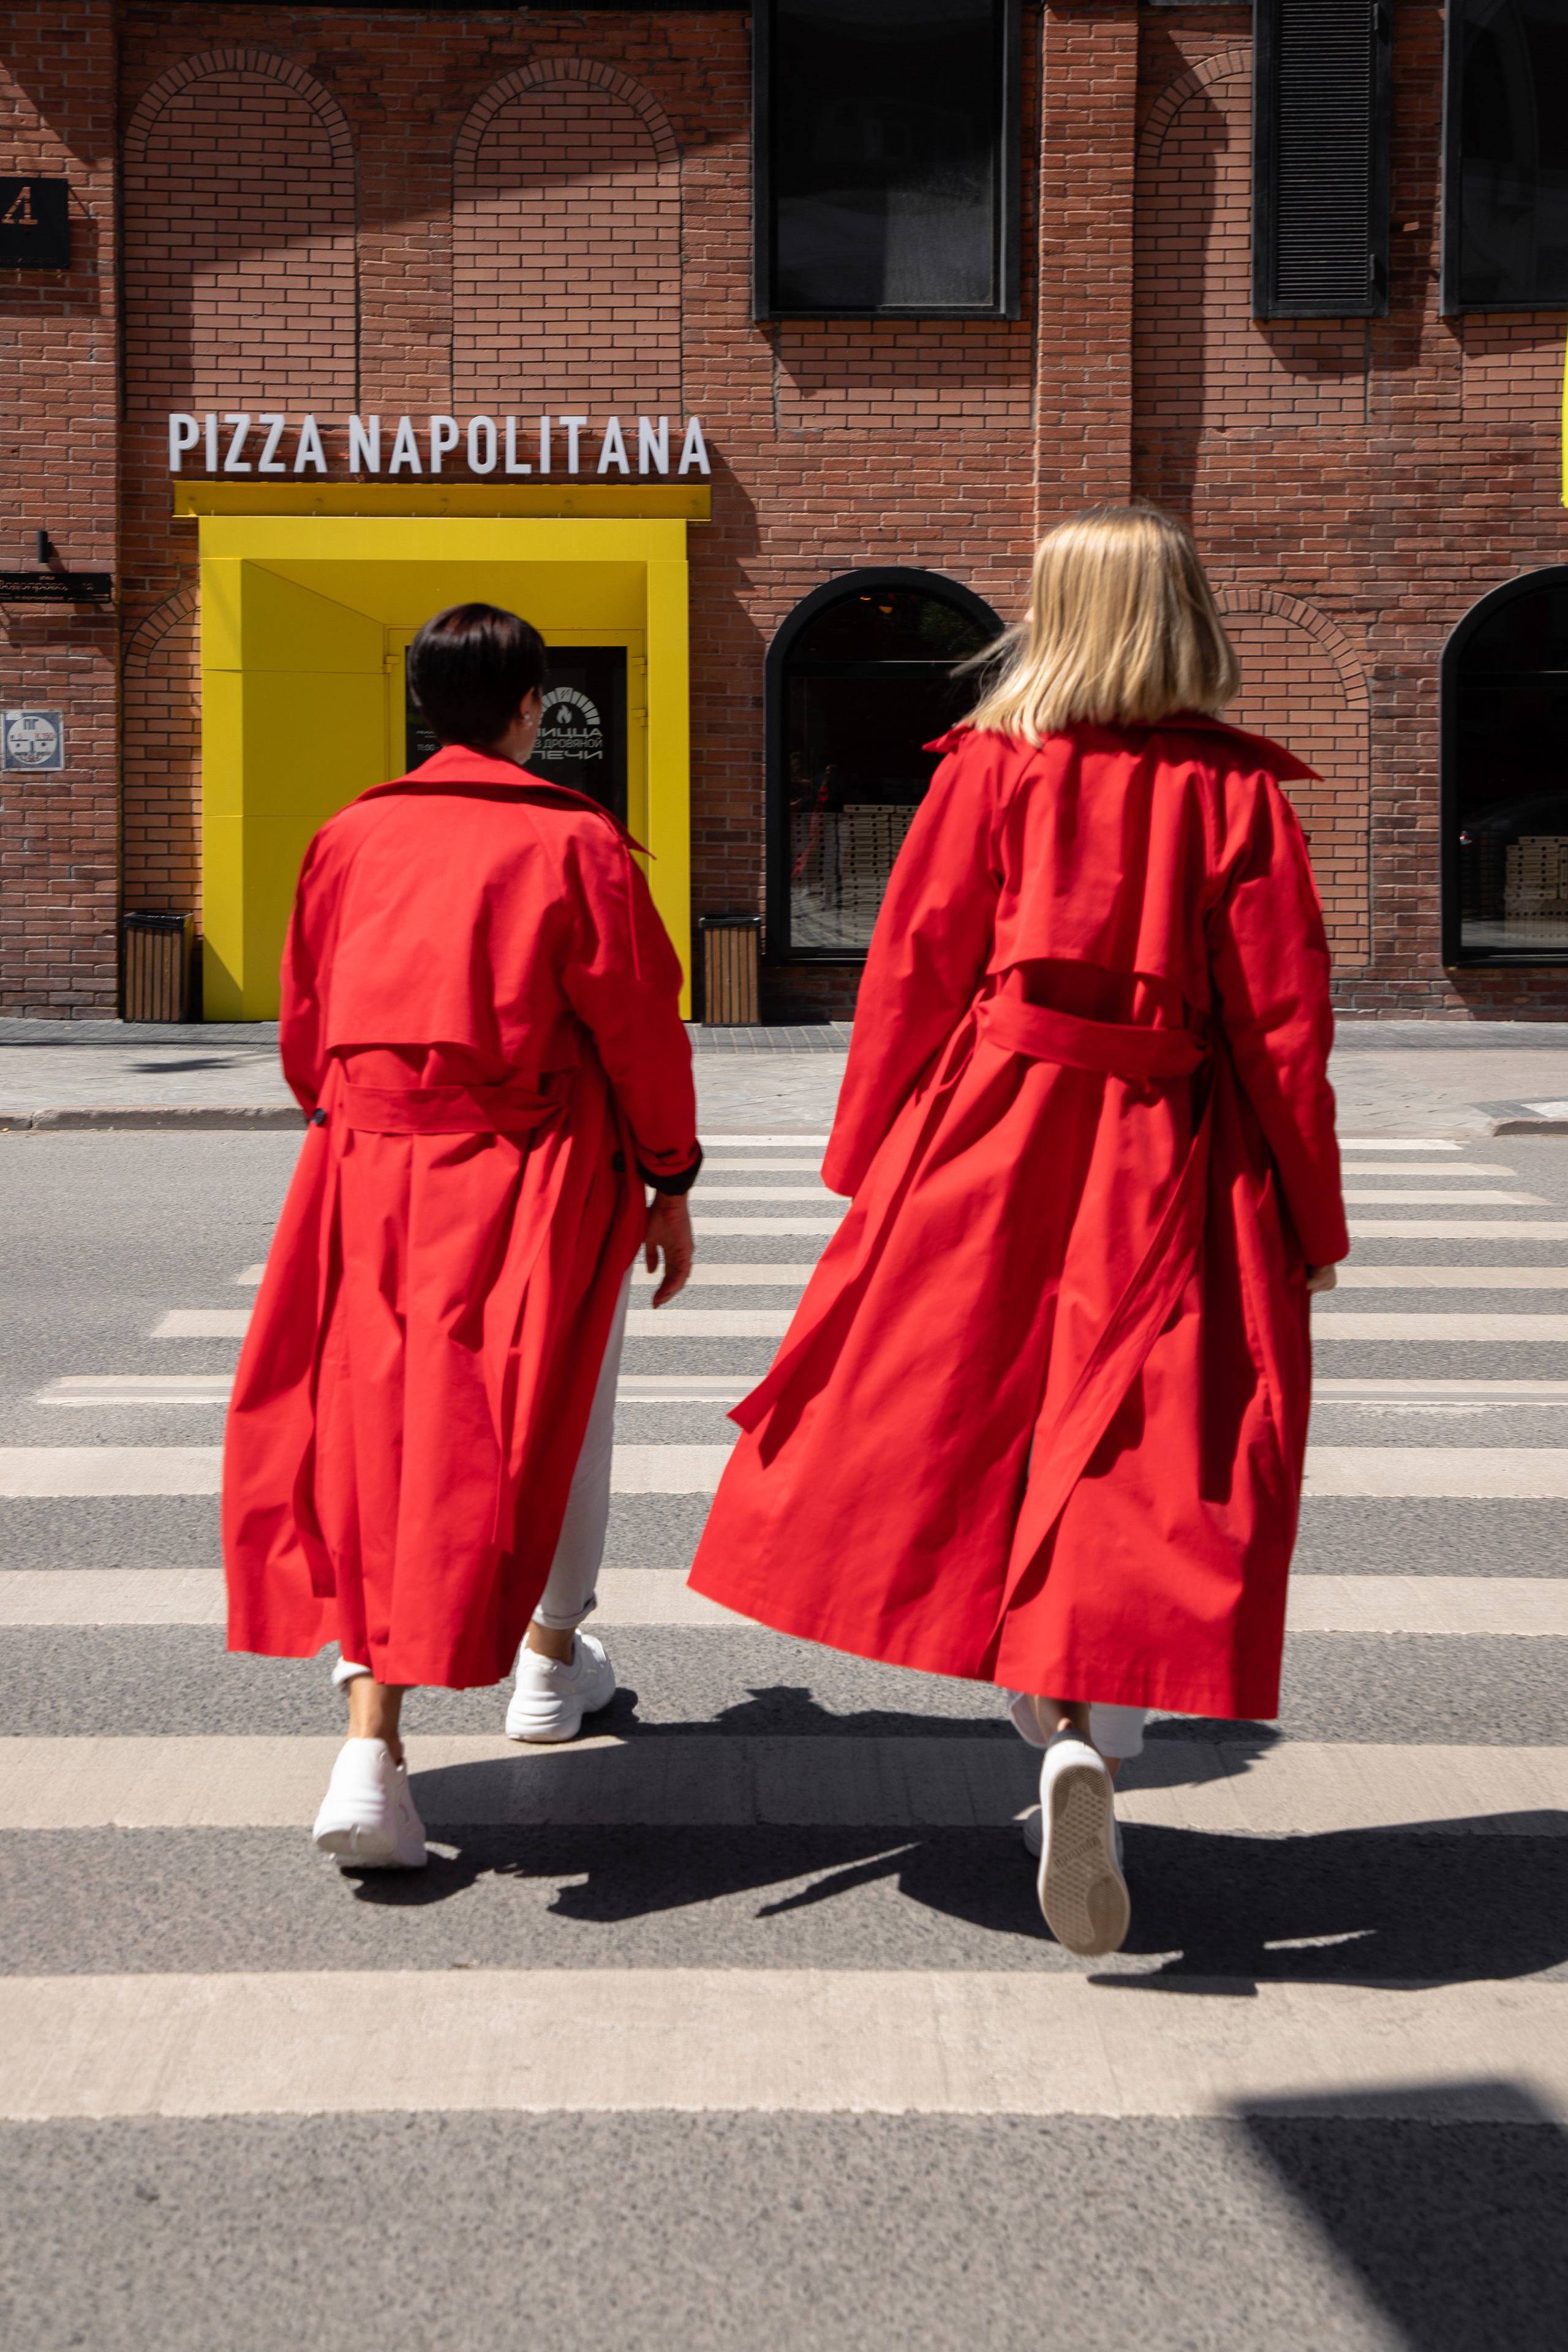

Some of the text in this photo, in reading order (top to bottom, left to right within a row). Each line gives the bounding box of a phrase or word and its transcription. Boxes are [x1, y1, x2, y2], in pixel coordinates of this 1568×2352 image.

[1, 186, 39, 236] 4
[168, 413, 712, 475] PIZZA NAPOLITANA
[23, 718, 39, 730] ПГ
[543, 737, 603, 749] ДРОВЯНОЙ
